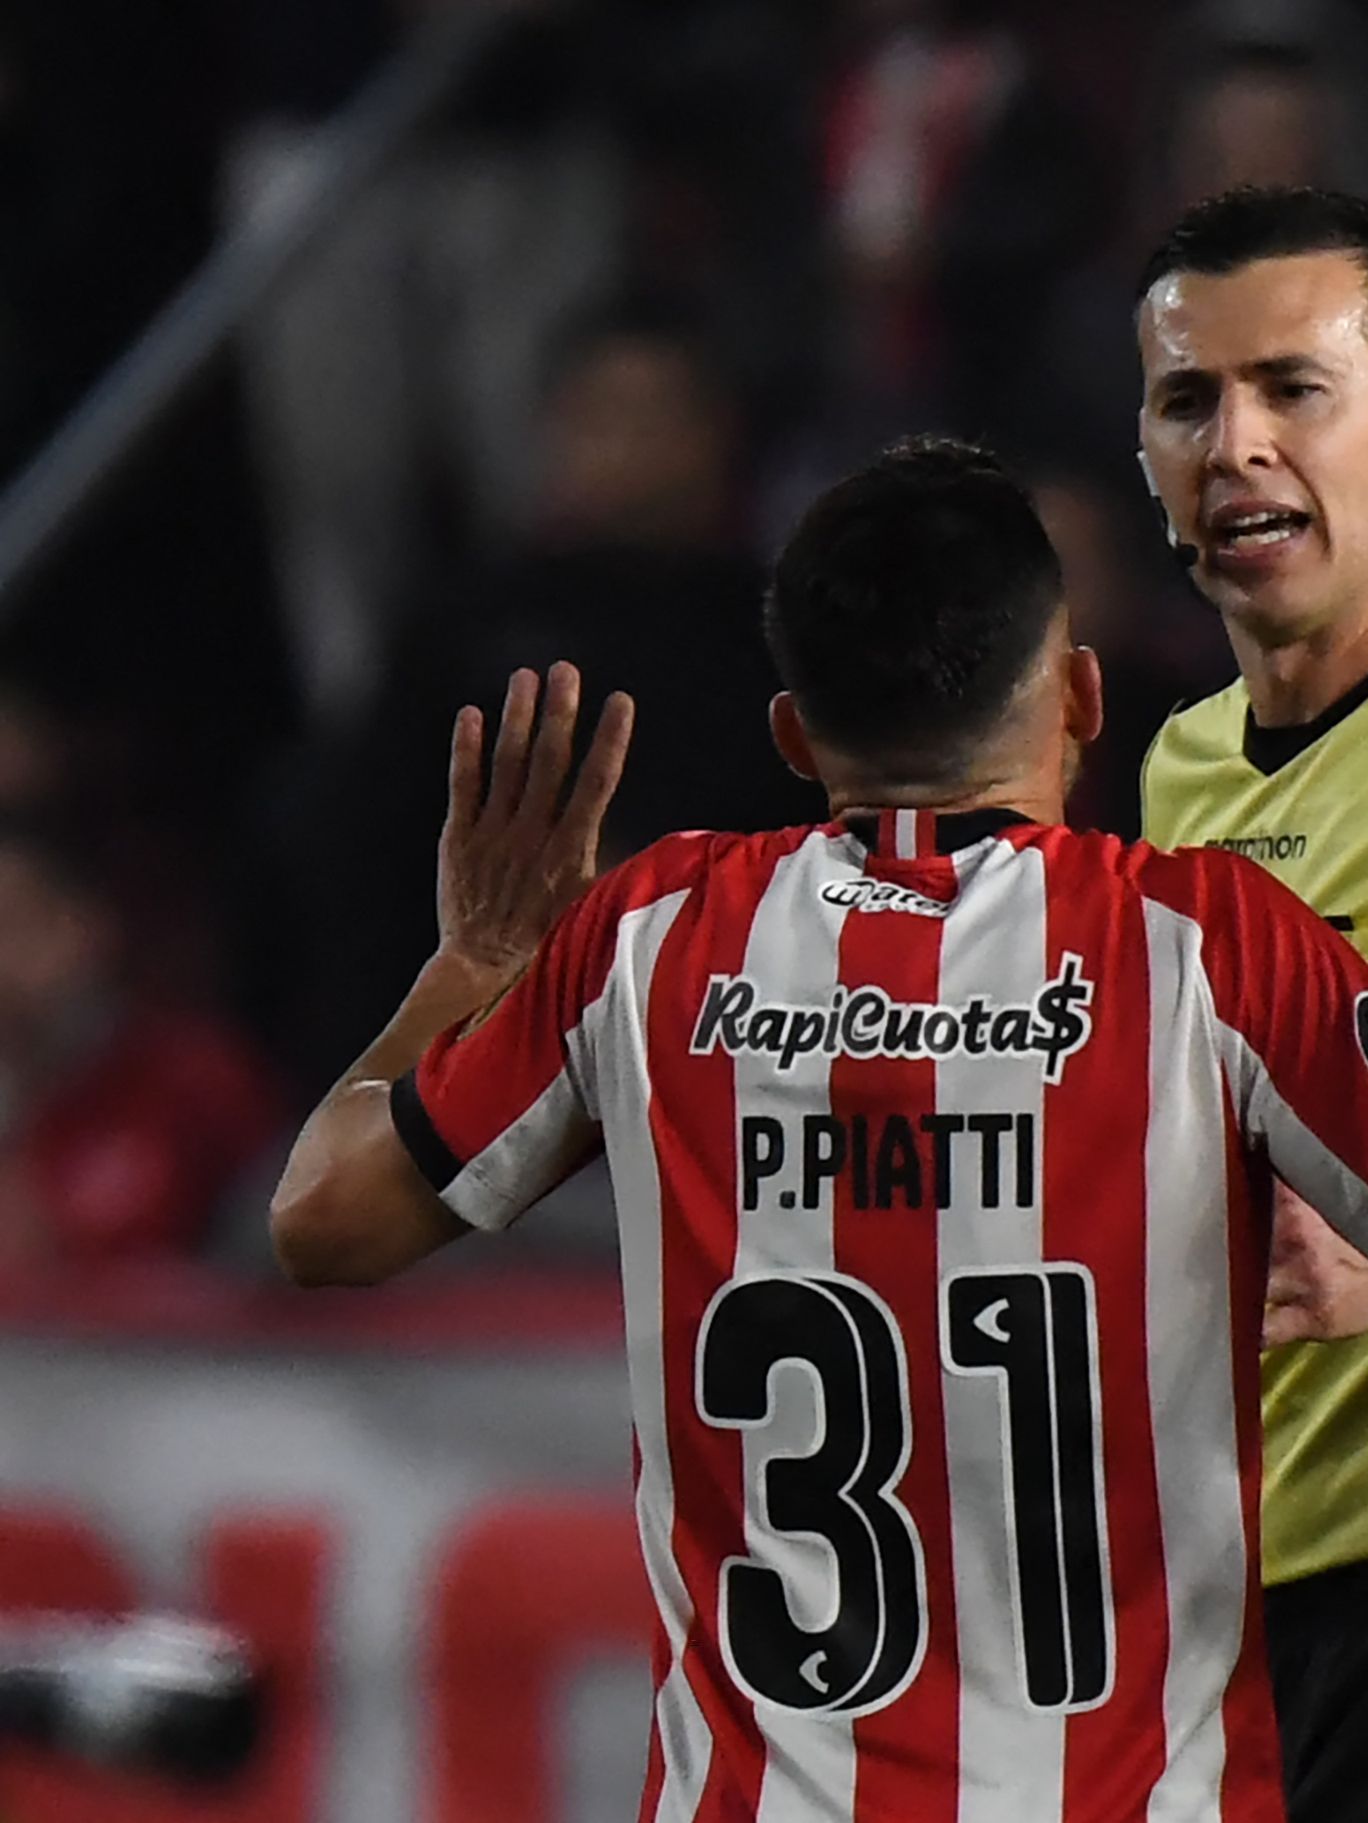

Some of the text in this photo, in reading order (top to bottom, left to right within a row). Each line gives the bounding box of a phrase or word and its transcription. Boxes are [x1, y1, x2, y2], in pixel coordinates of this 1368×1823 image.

[692, 956, 1091, 1081] RapiCuota$
[741, 1112, 1035, 1211] P.PIATTI
[696, 1262, 1115, 1717] 31
